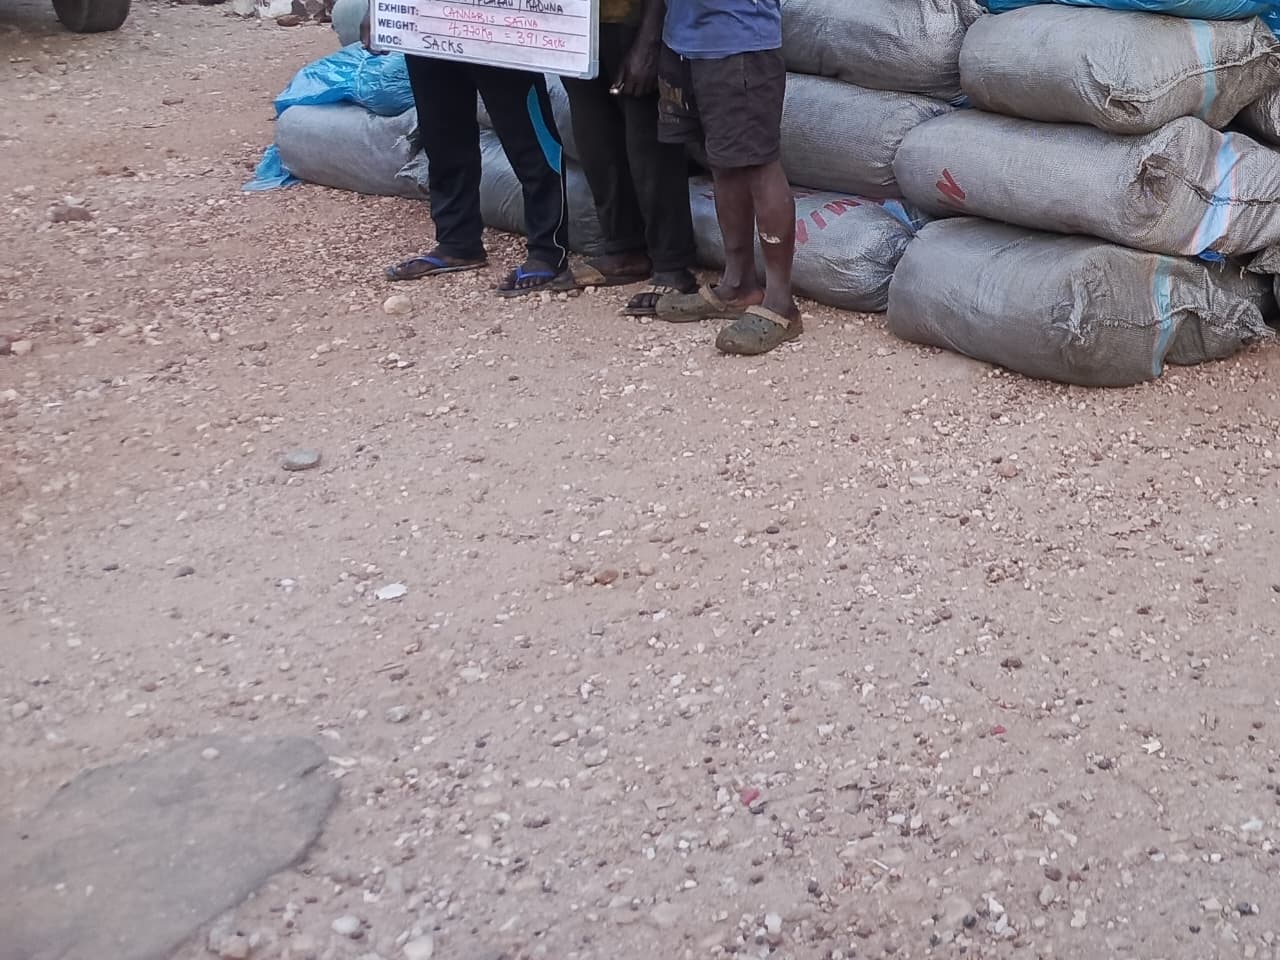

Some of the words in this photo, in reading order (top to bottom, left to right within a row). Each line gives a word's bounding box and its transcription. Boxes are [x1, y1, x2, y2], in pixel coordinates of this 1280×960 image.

[378, 3, 419, 16] EXHIBIT:
[378, 18, 418, 32] WEIGHT:
[378, 34, 402, 46] MOC:
[422, 36, 464, 54] SACKS
